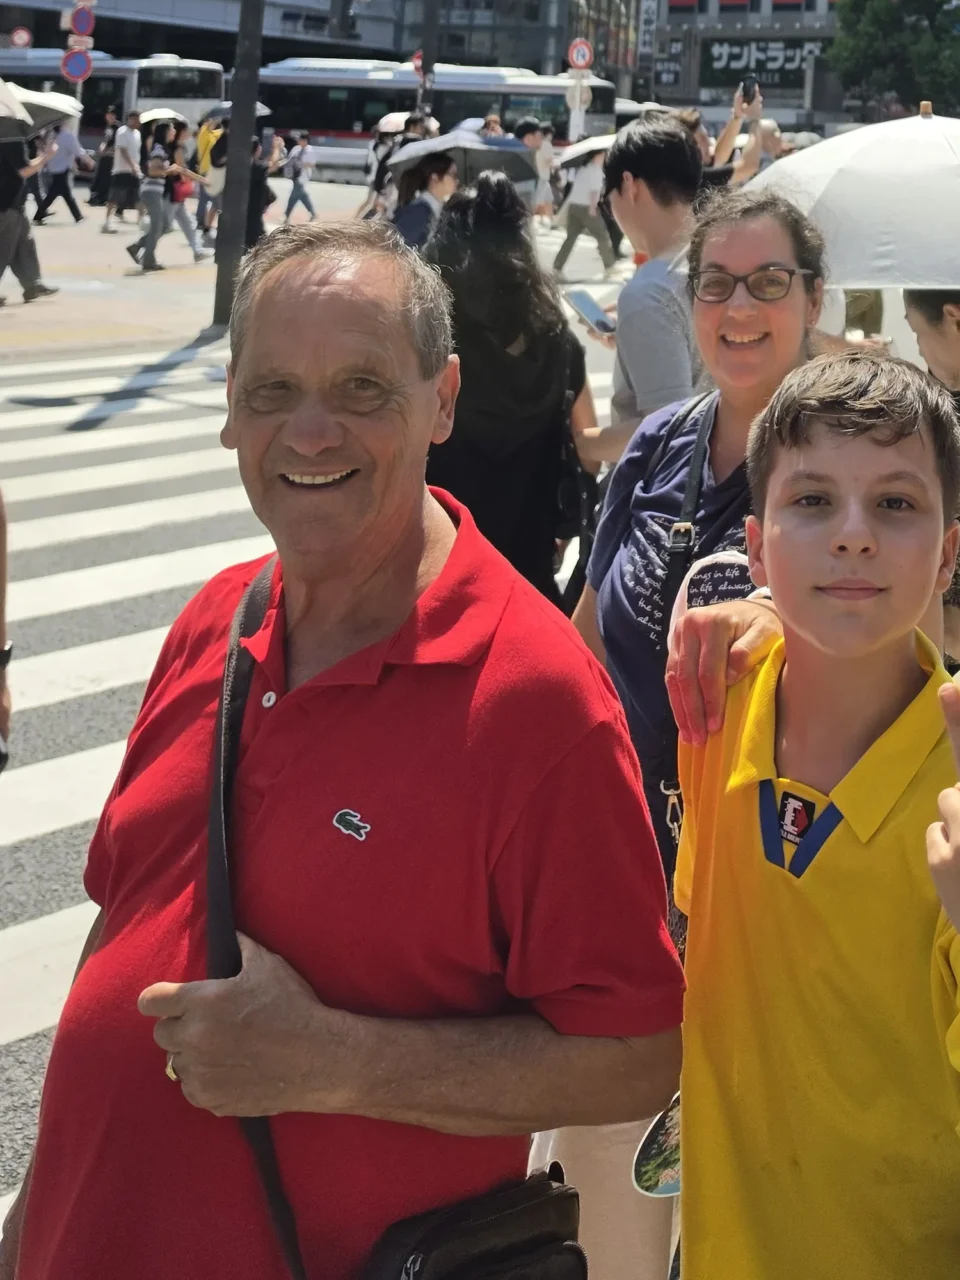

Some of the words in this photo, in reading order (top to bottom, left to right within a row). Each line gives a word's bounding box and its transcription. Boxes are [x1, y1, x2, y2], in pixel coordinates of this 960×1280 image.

[711, 41, 822, 70] サンドラッグ
